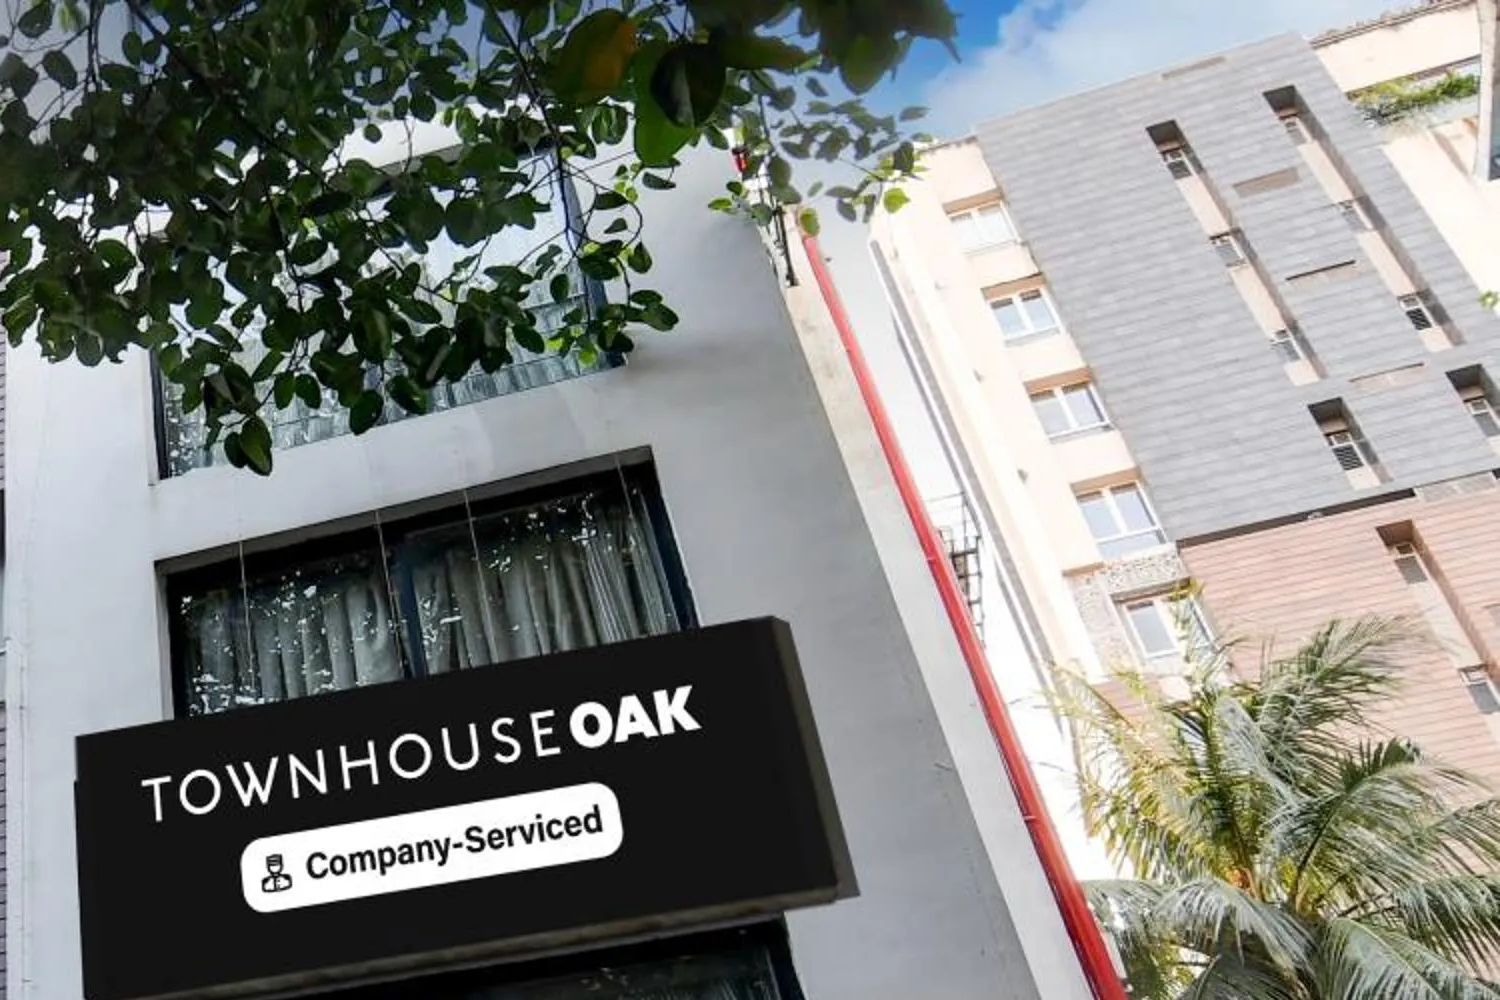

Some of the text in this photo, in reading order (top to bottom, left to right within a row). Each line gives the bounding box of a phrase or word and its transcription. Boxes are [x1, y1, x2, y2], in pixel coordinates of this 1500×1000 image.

[141, 685, 702, 822] TOWNHOUSE OAK
[306, 803, 604, 880] Company-Serviced
